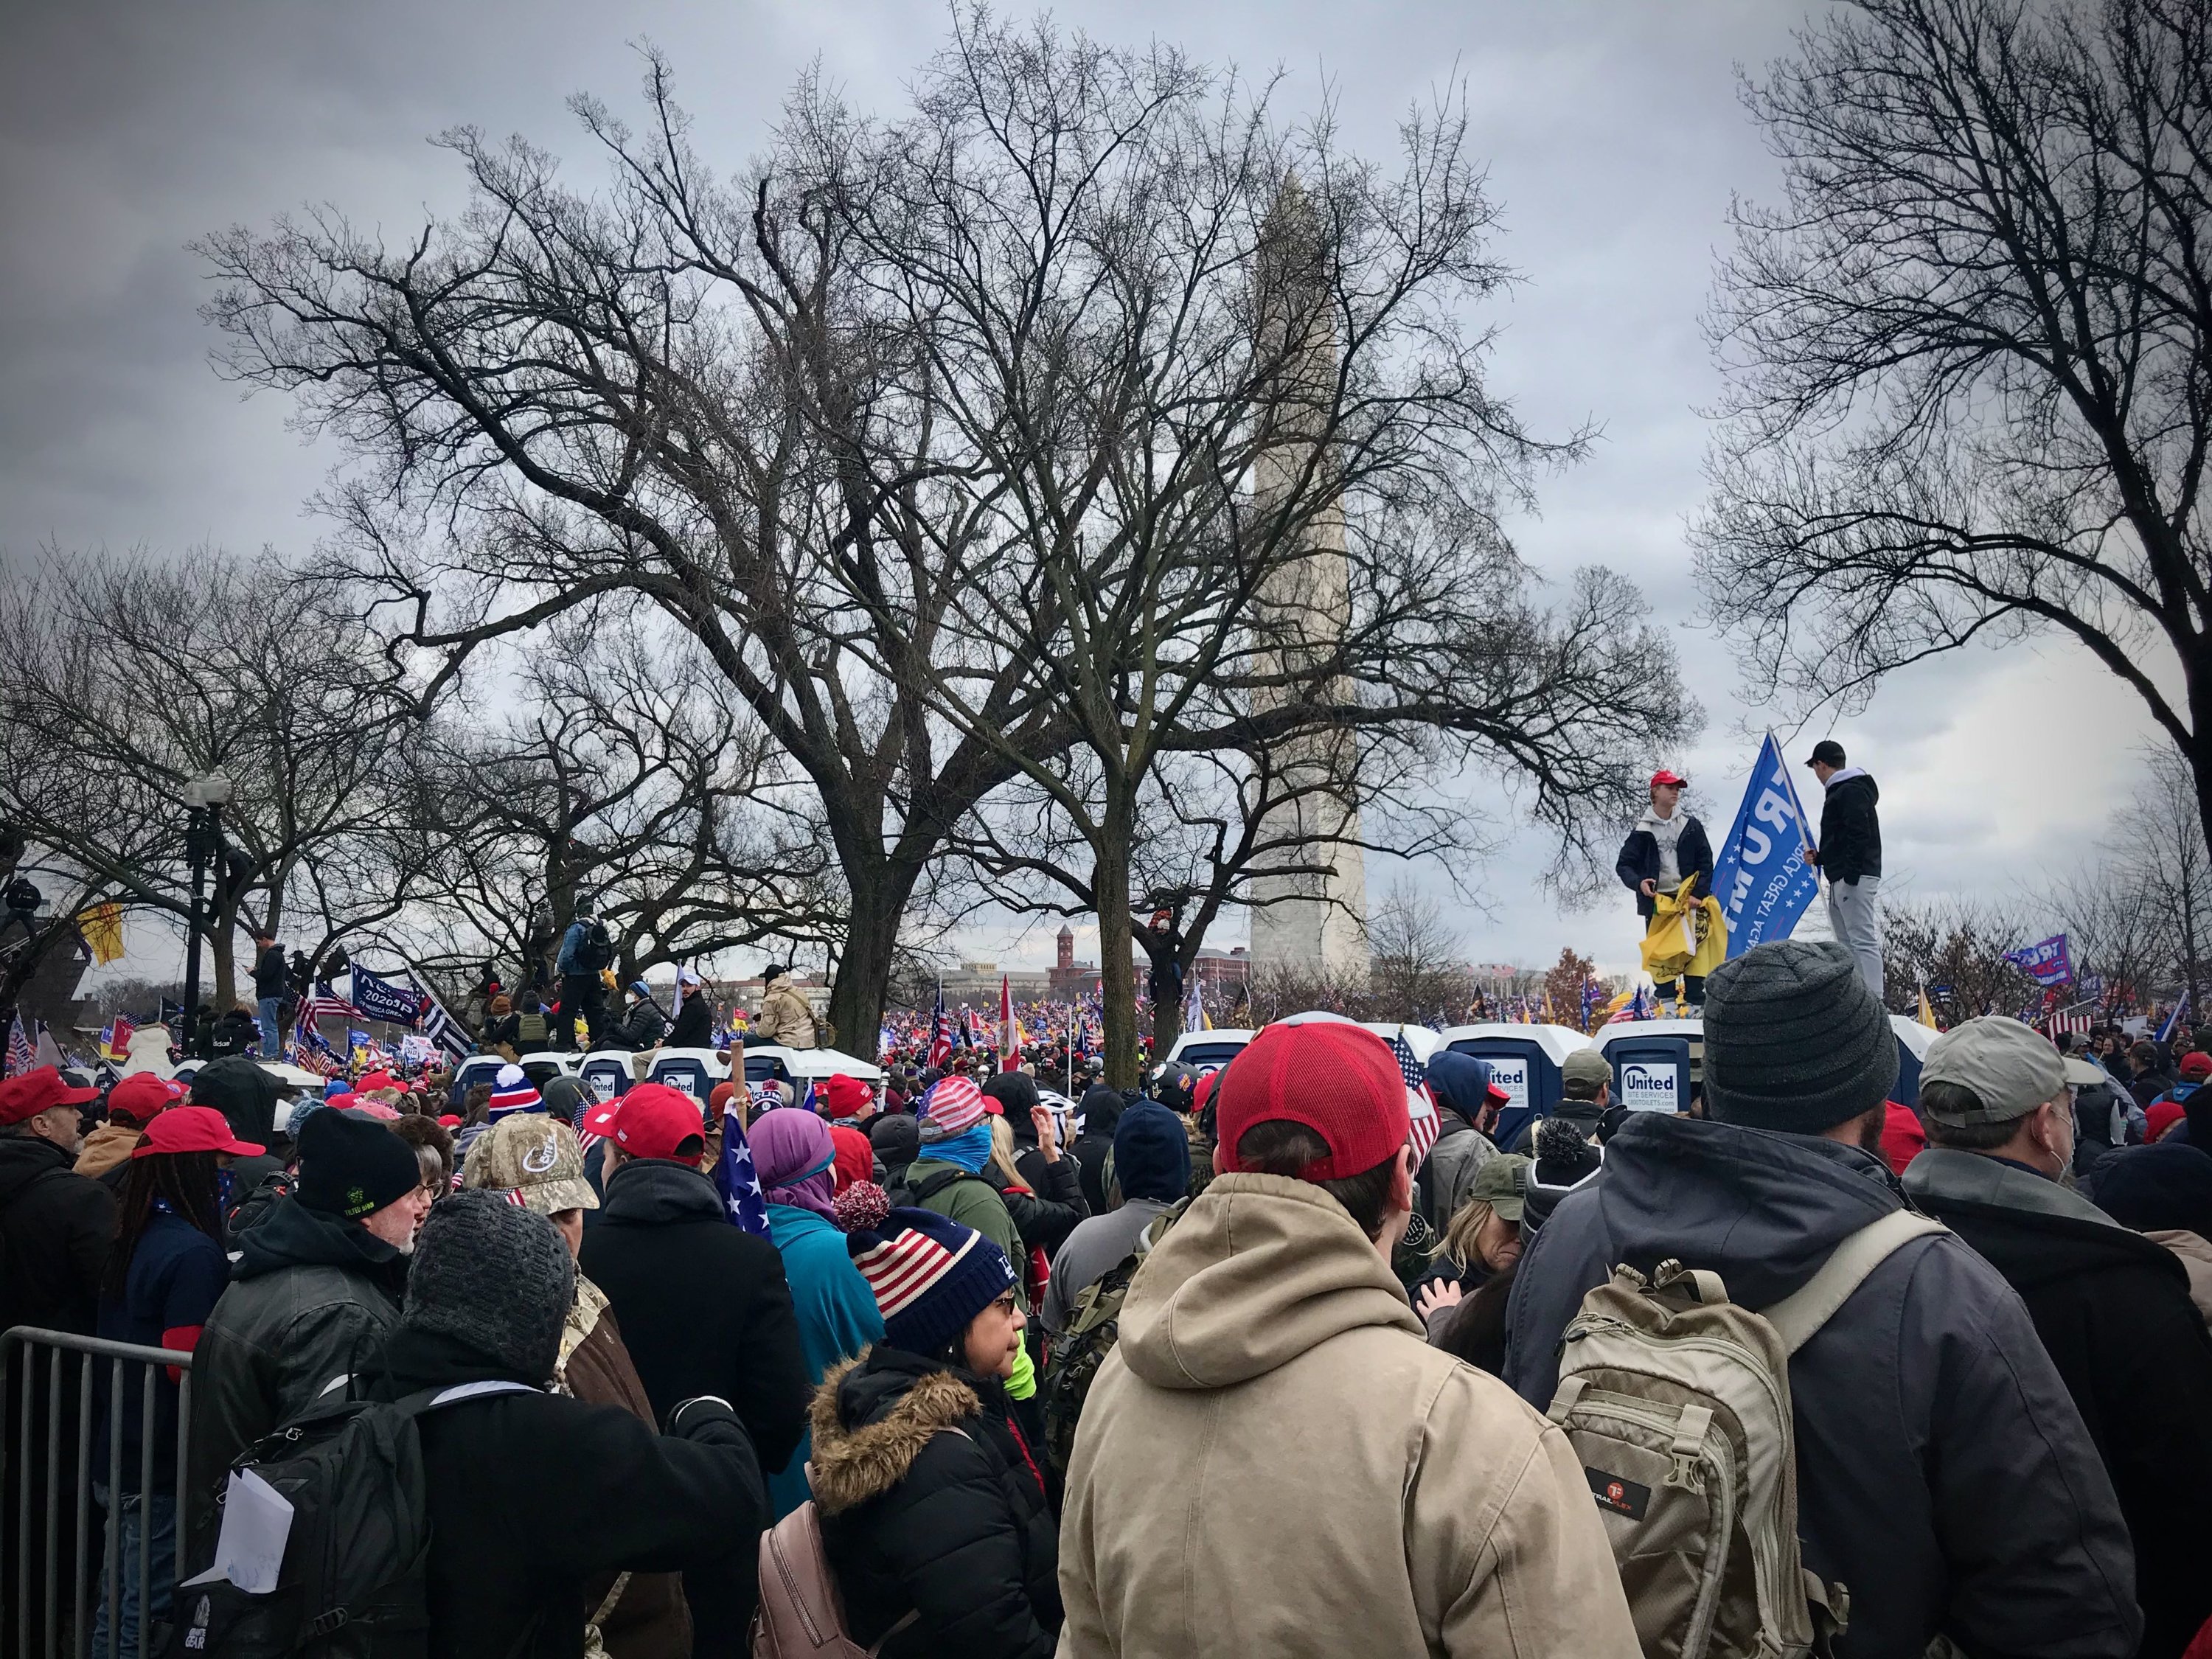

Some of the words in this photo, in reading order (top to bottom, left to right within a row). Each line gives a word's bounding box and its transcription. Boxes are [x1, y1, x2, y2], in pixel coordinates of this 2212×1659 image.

[365, 990, 394, 1006] 2020
[385, 1009, 403, 1018] GREA
[1491, 1070, 1523, 1084] ited
[1627, 1074, 1674, 1091] United
[592, 1081, 613, 1091] United
[666, 1081, 692, 1091] Uted
[753, 1091, 783, 1103] RUM
[539, 1142, 554, 1164] BITE
[185, 1635, 206, 1649] GEAR
